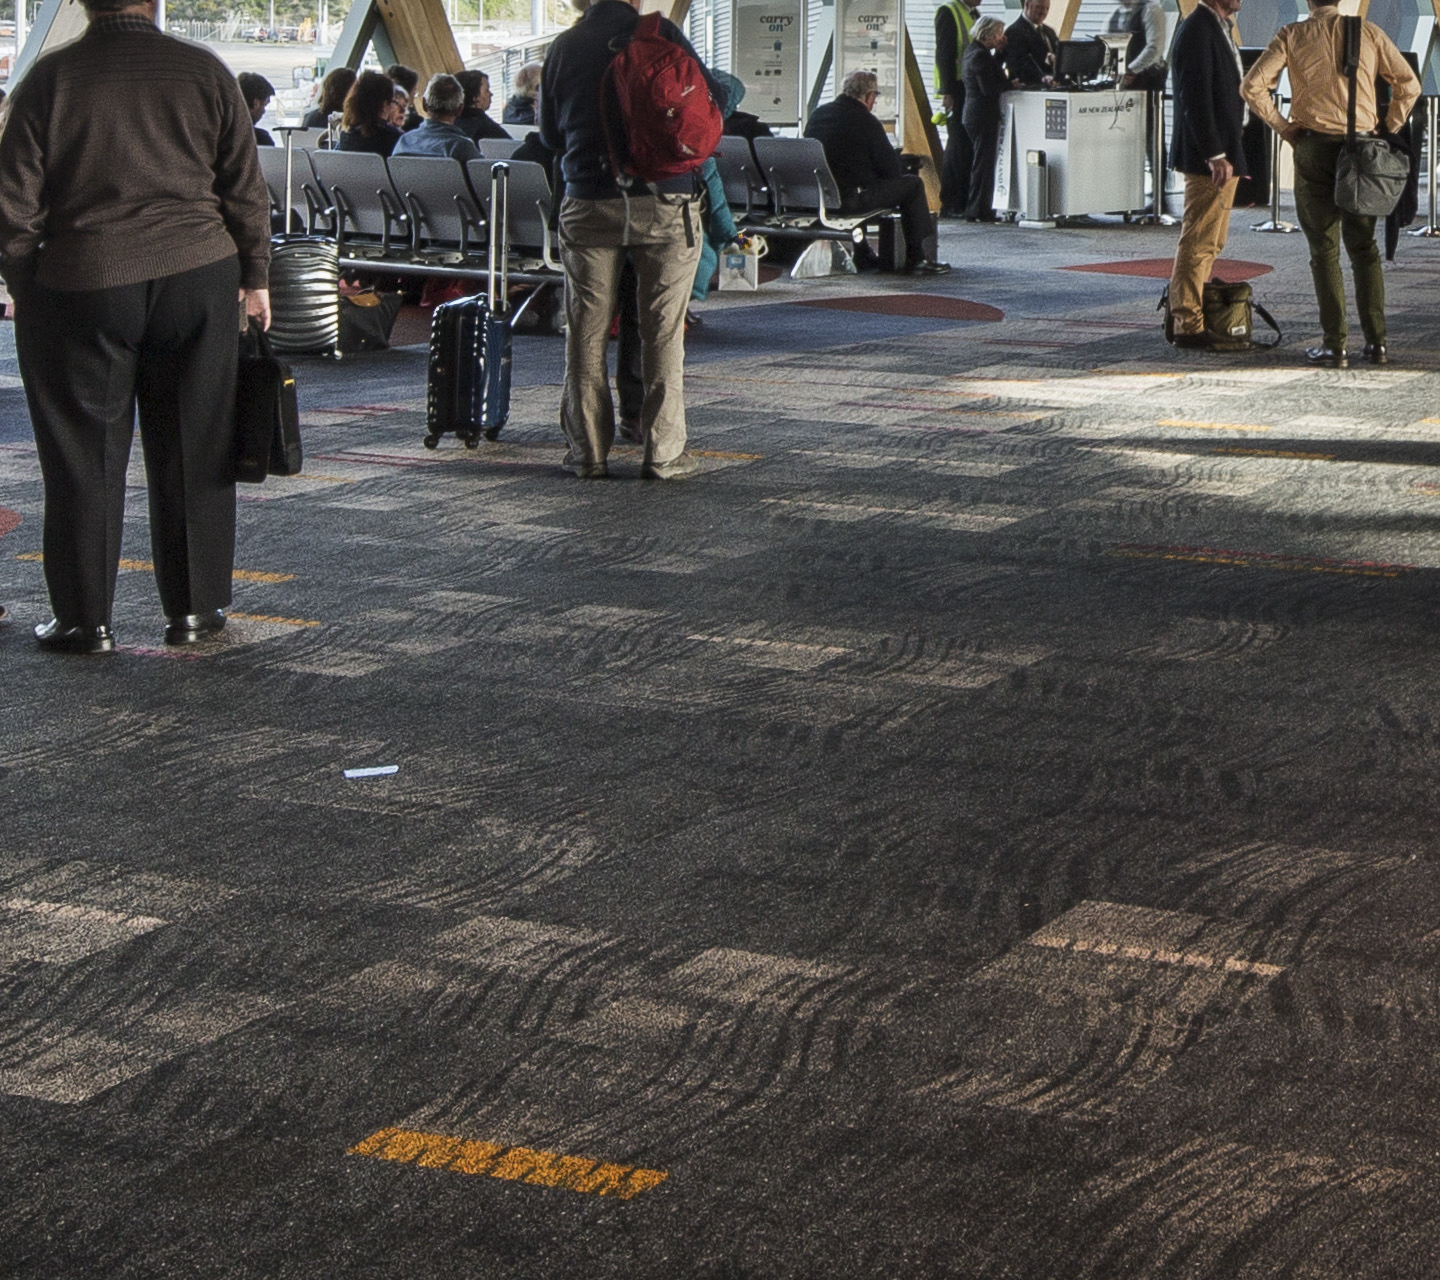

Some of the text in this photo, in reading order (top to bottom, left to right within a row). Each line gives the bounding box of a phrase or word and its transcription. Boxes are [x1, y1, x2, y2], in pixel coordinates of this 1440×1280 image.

[759, 13, 794, 27] carry
[857, 13, 889, 26] carry
[768, 22, 784, 32] on
[866, 22, 880, 32] on
